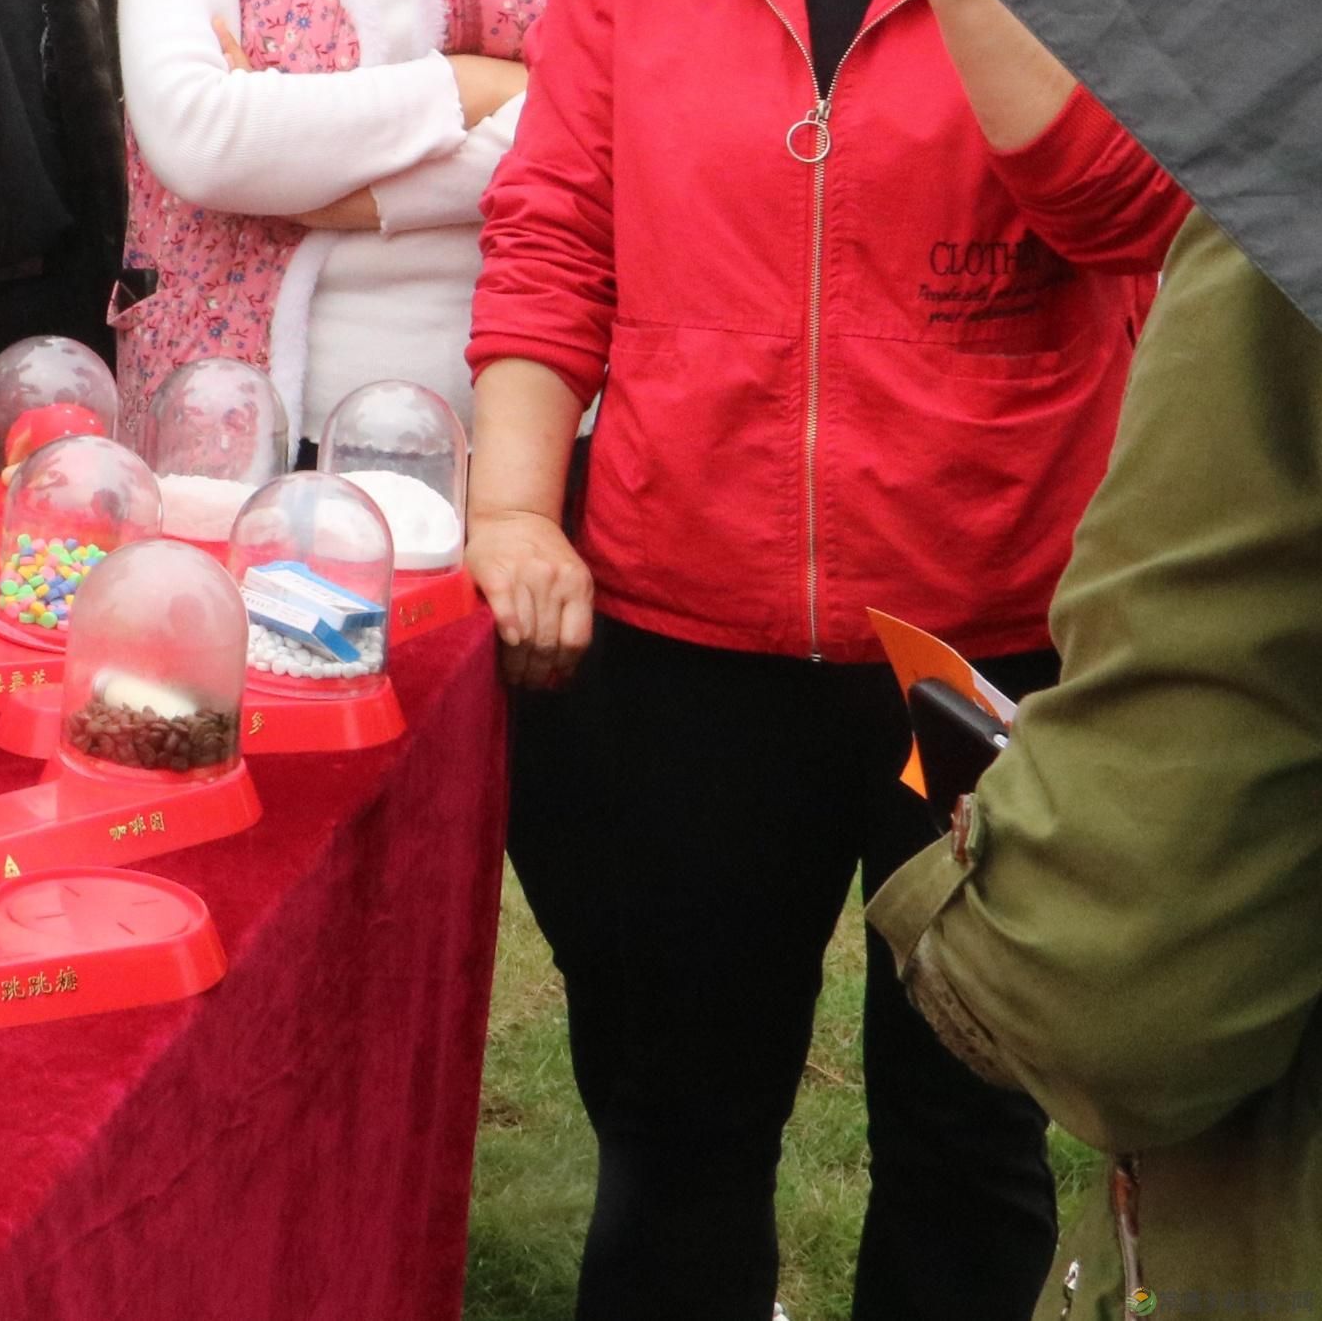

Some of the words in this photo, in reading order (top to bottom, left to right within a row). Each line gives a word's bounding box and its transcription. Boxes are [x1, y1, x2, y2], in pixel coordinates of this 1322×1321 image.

[109, 810, 166, 841] 咖啡因
[0, 965, 79, 1003] 跳跳糖
